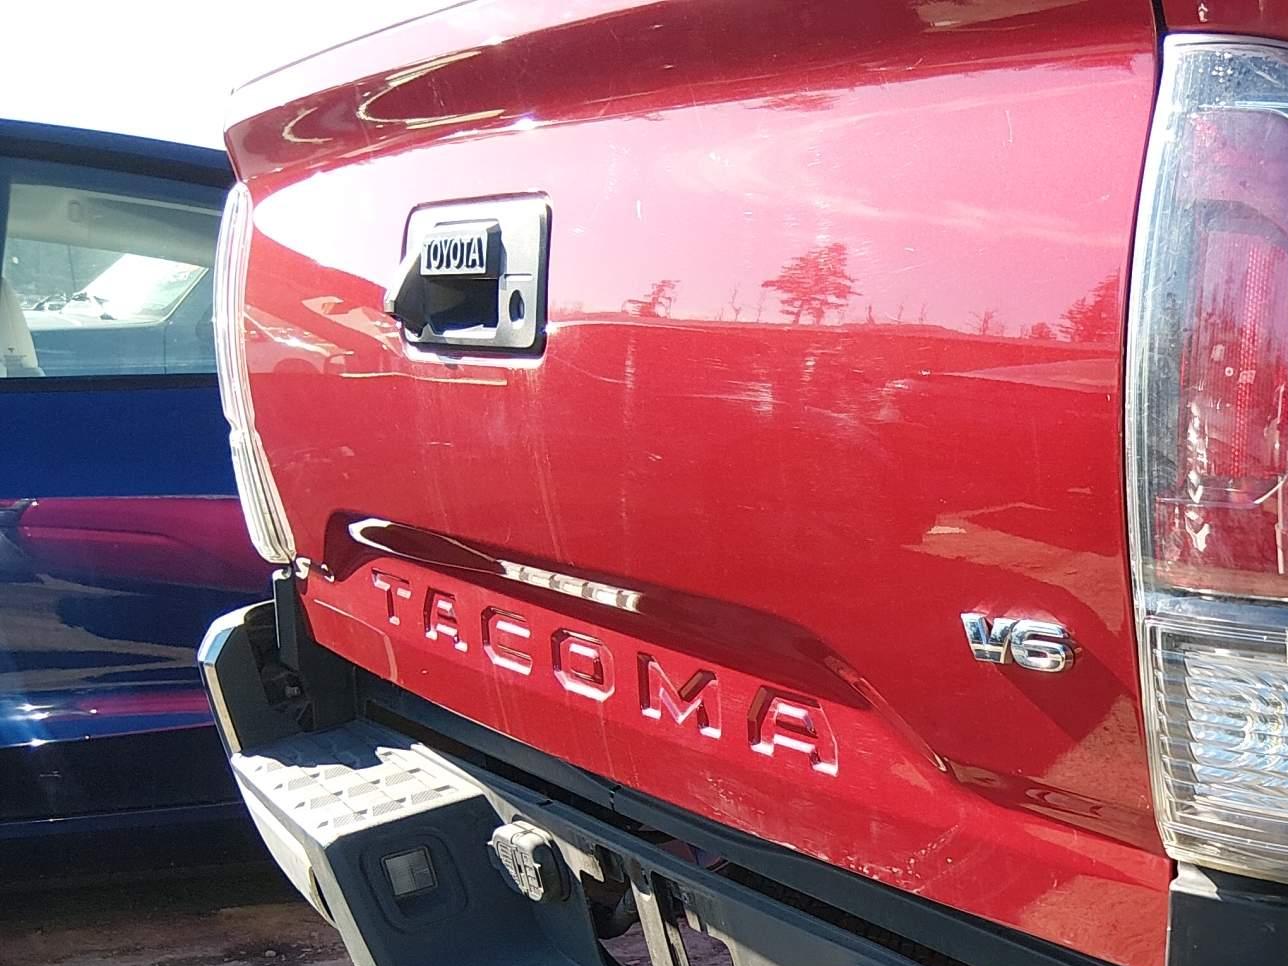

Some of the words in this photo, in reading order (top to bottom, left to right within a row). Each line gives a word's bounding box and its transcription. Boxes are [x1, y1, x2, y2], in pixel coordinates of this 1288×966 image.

[423, 236, 485, 270] TOYOTA
[960, 612, 1072, 672] V6
[371, 568, 839, 777] TACOMA
